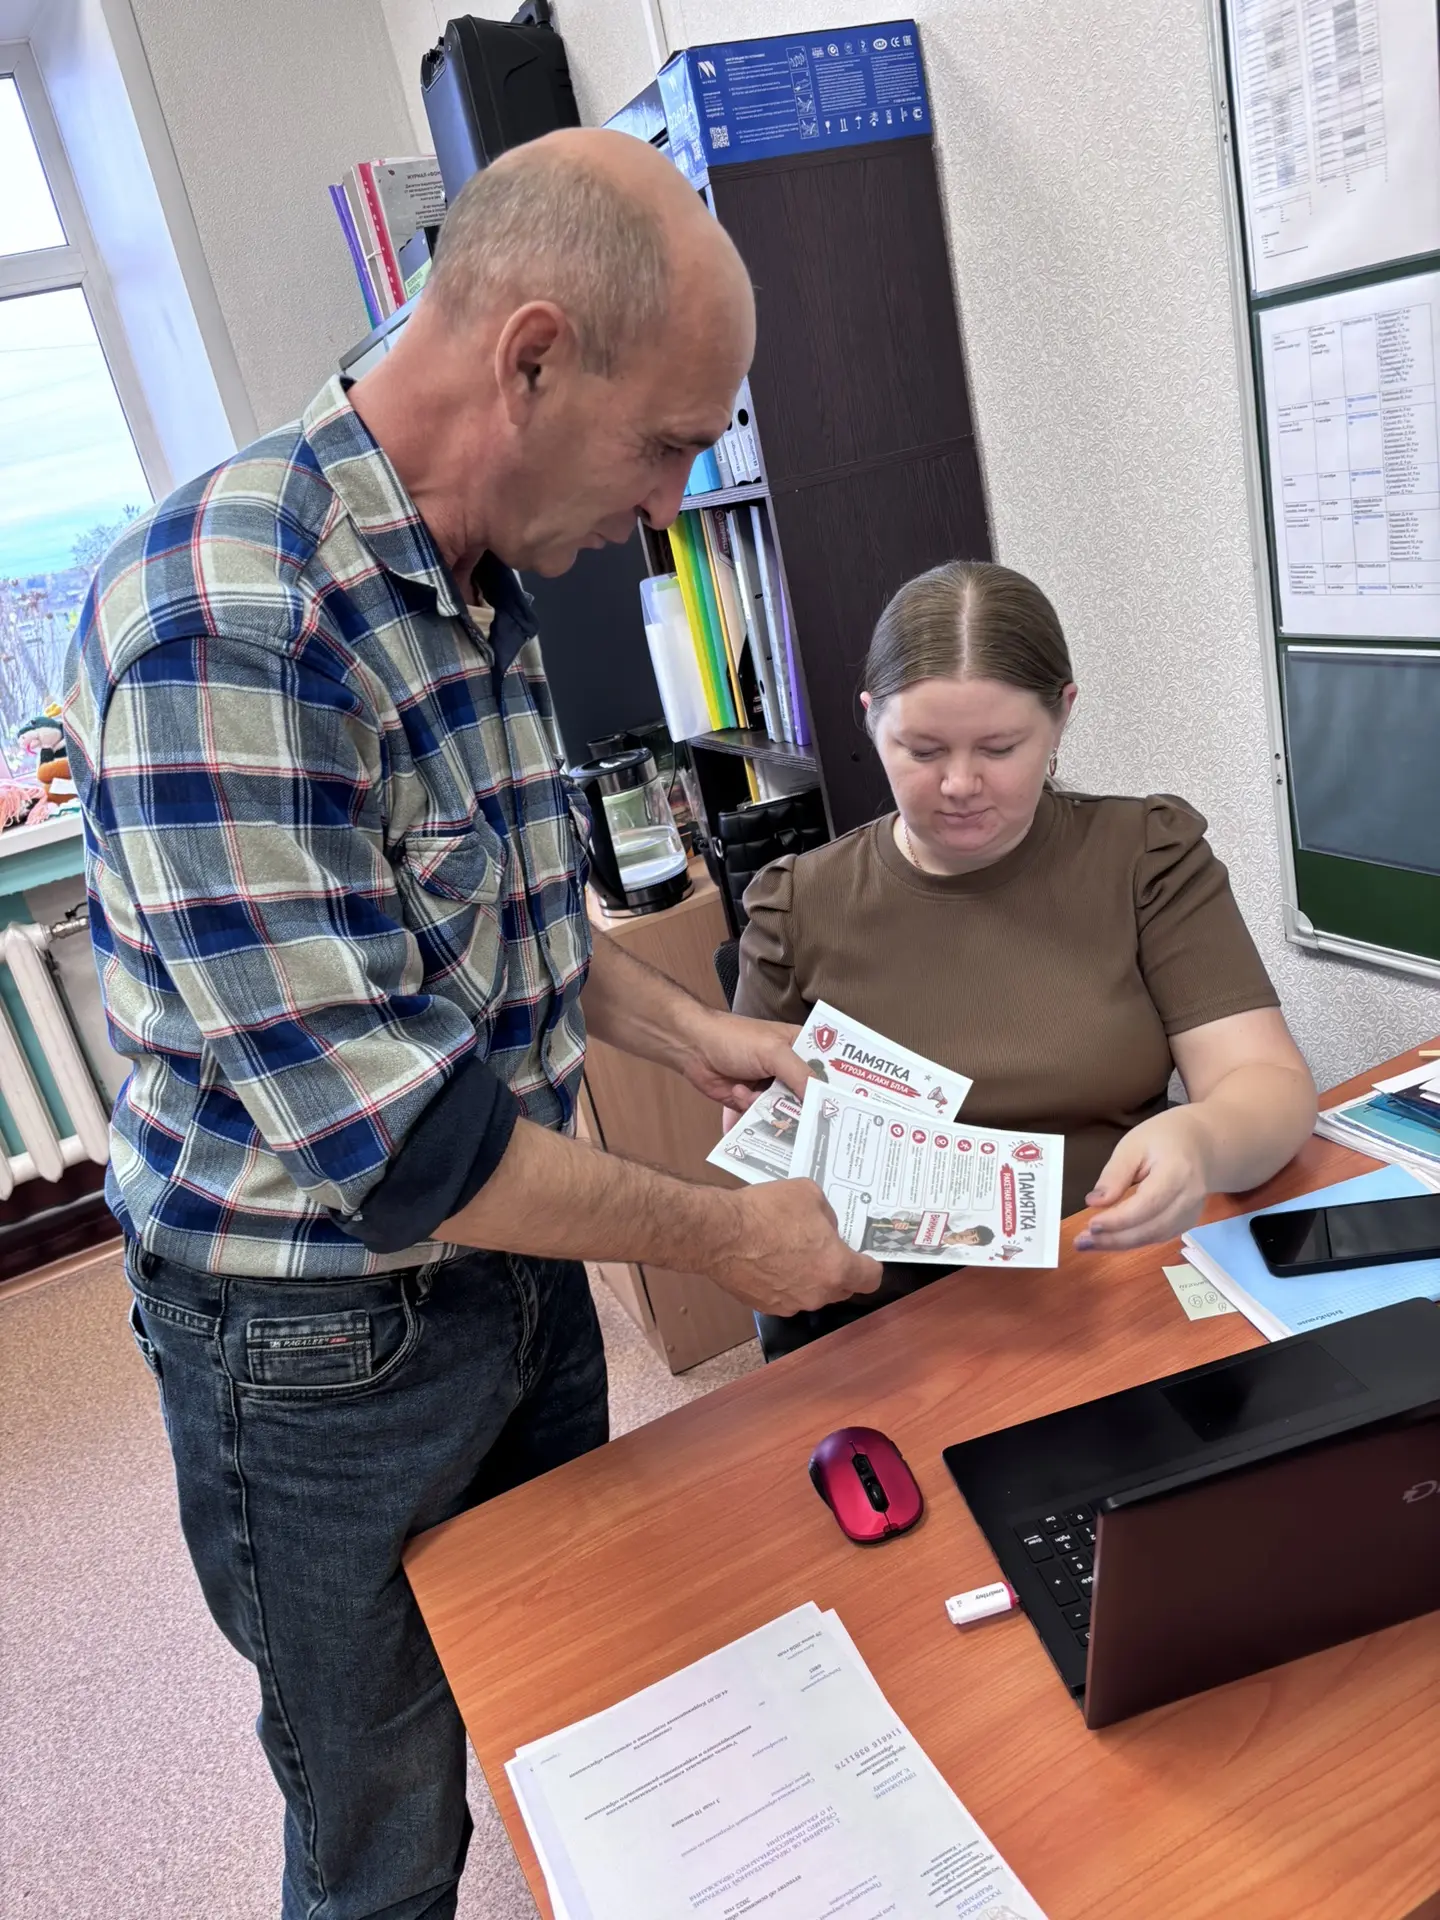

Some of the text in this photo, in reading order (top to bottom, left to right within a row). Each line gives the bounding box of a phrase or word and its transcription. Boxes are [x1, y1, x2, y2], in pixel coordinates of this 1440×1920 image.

[841, 1042, 912, 1082] ПАМЯТКА
[839, 1062, 909, 1093] УГРОЗА АТАКИ БПЛА
[1003, 1172, 1012, 1231] РАКЕТНАЯ ОПАСНОСТЬ
[1018, 1172, 1036, 1230] ПАМЯТКА
[922, 1215, 940, 1243] ВНИМАНИЕ!
[975, 1588, 1004, 1600] smartbuy
[871, 1769, 904, 1793] ДИПЛОМУ
[874, 1771, 916, 1800] ПРИЛОЖЕНИЕ
[764, 1812, 819, 1847] КВАЛИФИКАЦИИ
[790, 1840, 801, 1849] ОБ
[800, 1821, 834, 1843] СВЕДЕНИЯ
[687, 1810, 838, 1902] СРЕДНЕГО ПРОФЕССИОНАЛЬНОГО ОБРАЗОВАНИЯ
[729, 1846, 793, 1886] ОБРАЗОВАТЕЛЬНОЙ
[691, 1882, 731, 1908] ПРОГРАММЕ
[954, 1883, 994, 1910] ФЕДЕРАЦИЯ
[957, 1888, 1002, 1919] РОССИЙСКАЯ
